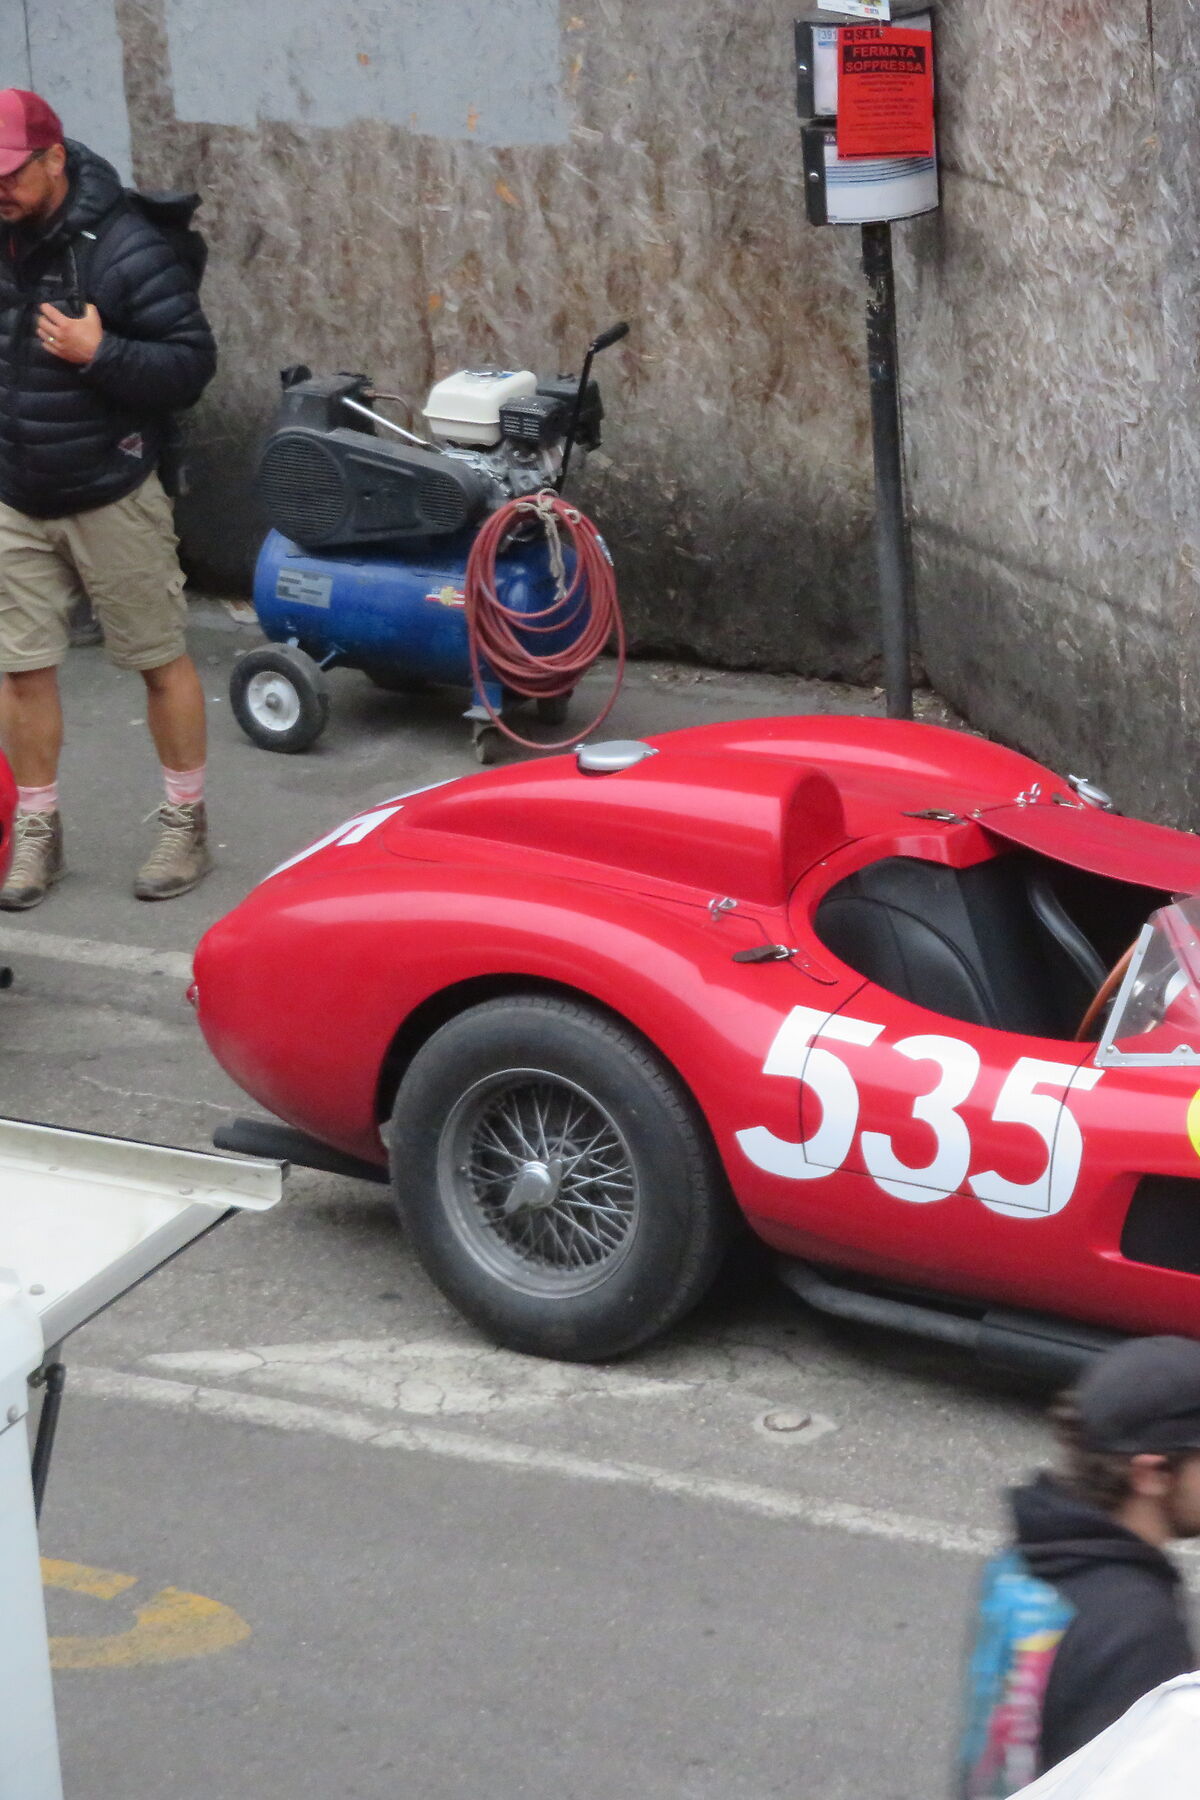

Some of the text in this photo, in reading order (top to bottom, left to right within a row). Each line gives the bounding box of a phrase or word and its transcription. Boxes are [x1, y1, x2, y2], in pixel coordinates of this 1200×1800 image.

[854, 29, 881, 40] SETA
[852, 46, 916, 58] FERMATA
[845, 61, 924, 73] SOPPRESSA
[735, 1005, 1106, 1219] 535
